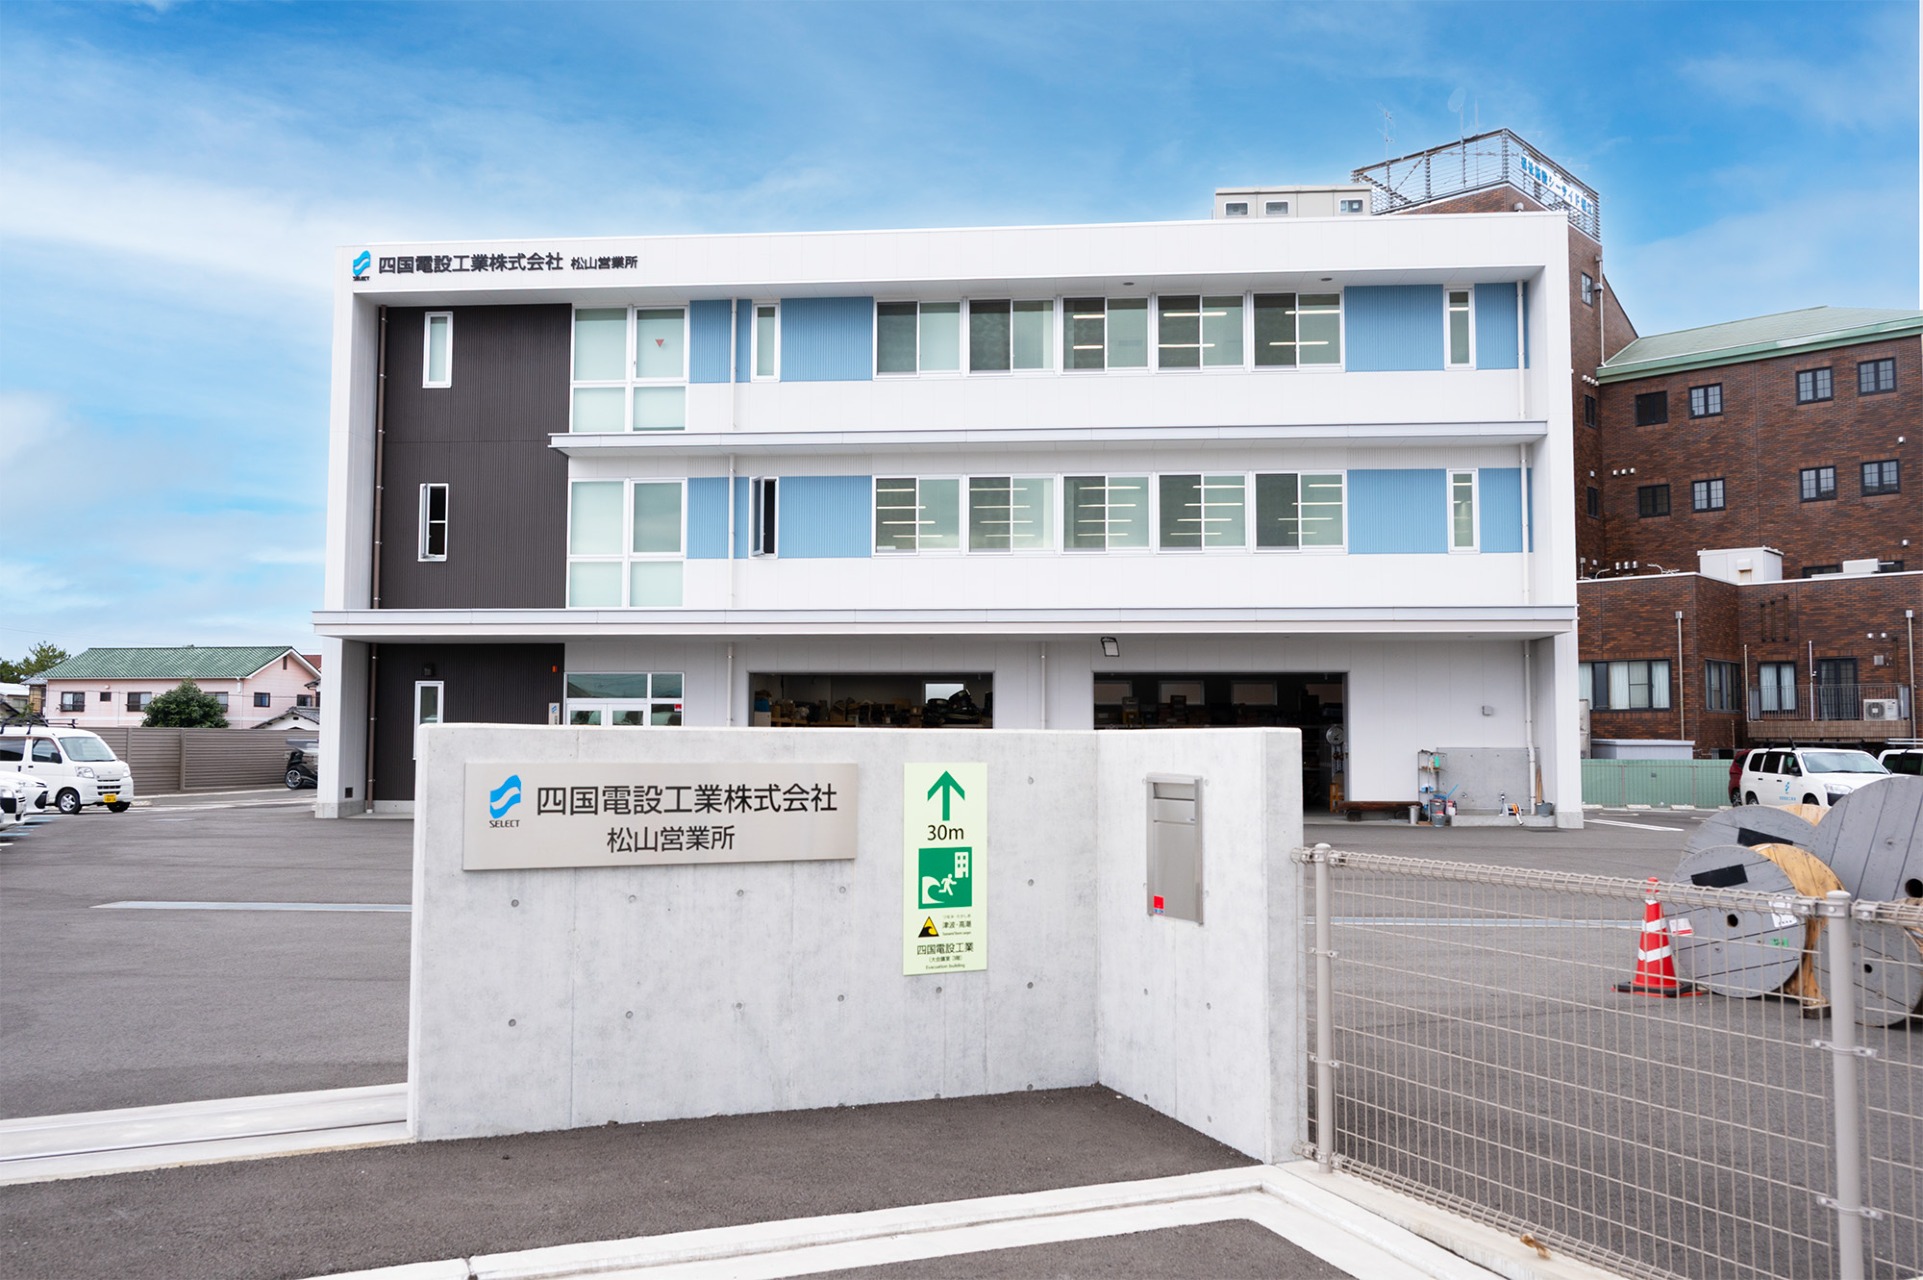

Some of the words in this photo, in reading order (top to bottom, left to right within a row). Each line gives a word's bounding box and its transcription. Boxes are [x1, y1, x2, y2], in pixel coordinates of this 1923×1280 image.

[379, 252, 564, 274] 四国電設工業株式会社
[571, 255, 638, 271] 松山営業所
[536, 783, 838, 816] 四国電設工業株式会社
[489, 819, 520, 828] SELECT
[927, 824, 964, 840] 30m
[606, 825, 736, 853] 松山営業所
[917, 942, 974, 956] 四国電設工業
